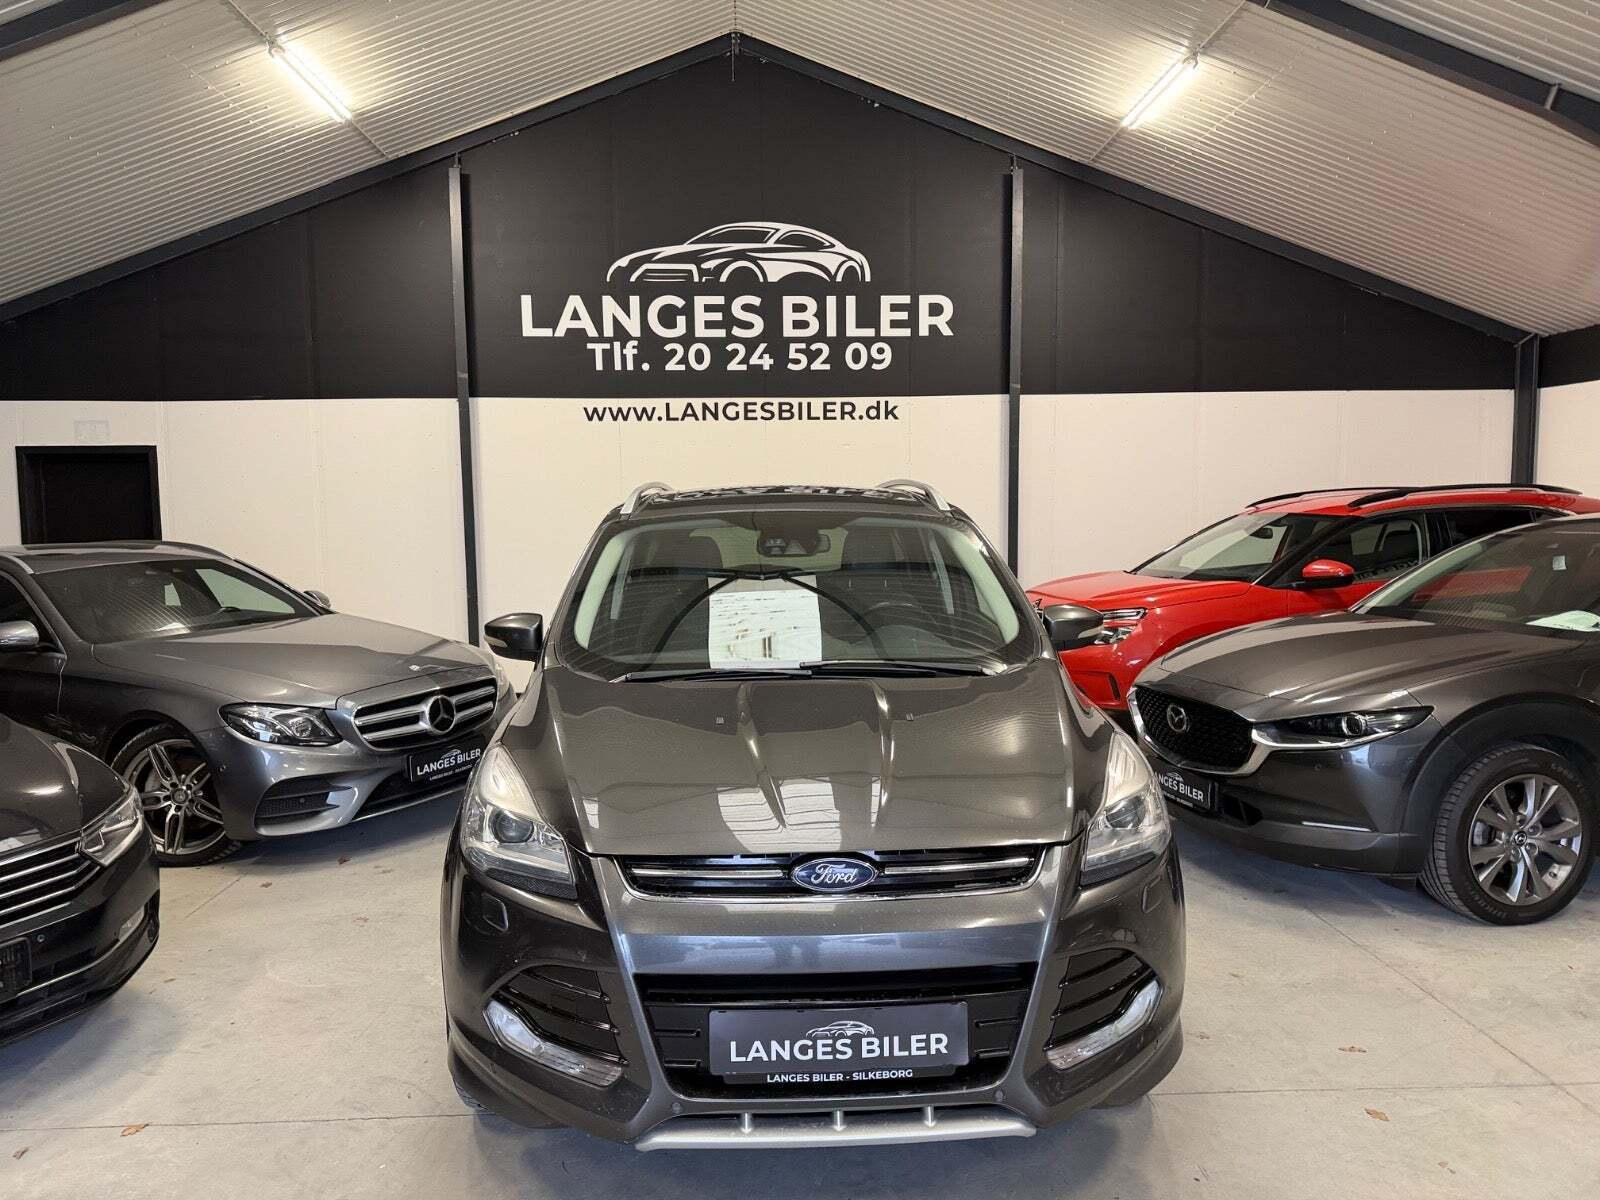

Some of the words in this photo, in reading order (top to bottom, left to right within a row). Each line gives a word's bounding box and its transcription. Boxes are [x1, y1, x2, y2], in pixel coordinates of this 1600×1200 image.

[520, 294, 765, 338] LANGES
[782, 294, 954, 338] BILER
[586, 339, 650, 372] Tlf.
[663, 342, 711, 371] 20
[725, 342, 774, 371] 24
[786, 342, 831, 371] 52
[844, 341, 893, 371] 09
[583, 400, 899, 422] www.LANGESBILER.dk
[416, 756, 456, 776] LANGES
[457, 748, 481, 764] BILER
[1179, 783, 1204, 803] BILER
[811, 863, 858, 884] Ford
[730, 1037, 853, 1063] LANGES
[861, 1033, 949, 1059] BILER
[767, 1073, 811, 1083] LANGES
[812, 1073, 844, 1082] BILER
[852, 1069, 913, 1081] SILKEBORG
